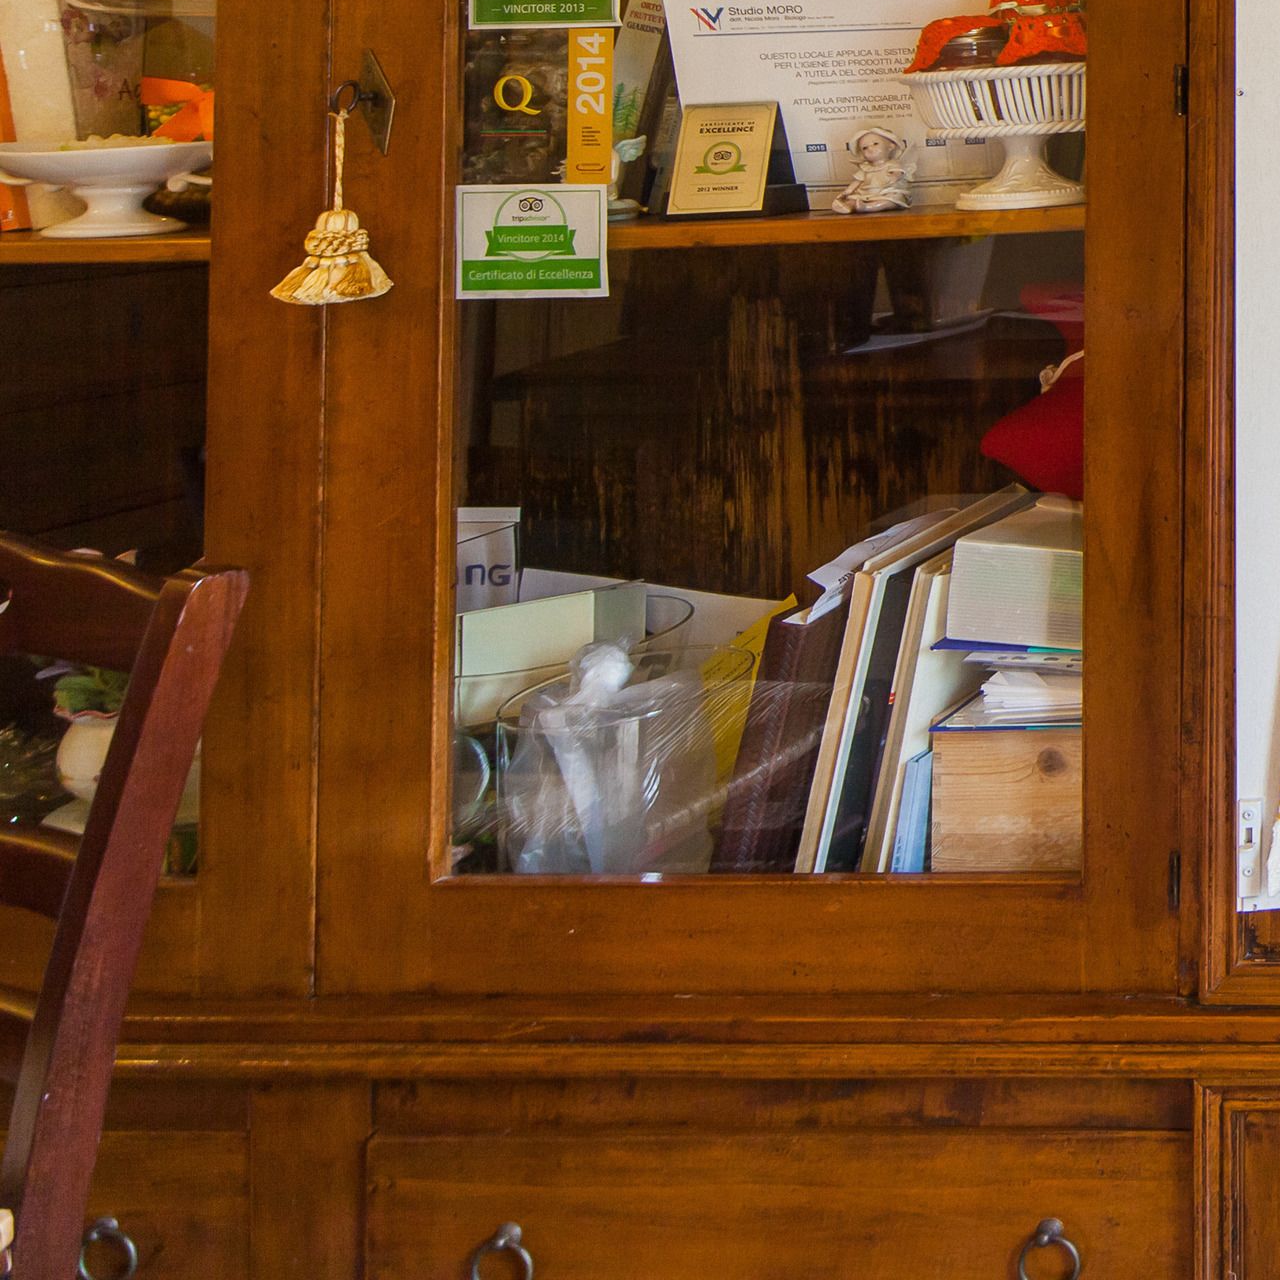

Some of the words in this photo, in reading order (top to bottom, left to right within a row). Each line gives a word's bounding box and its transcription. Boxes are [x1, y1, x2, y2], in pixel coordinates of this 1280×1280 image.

[503, 4, 556, 14] VINCITORE
[560, 3, 585, 13] 2013
[640, 1, 663, 12] ORTO
[728, 6, 764, 16] Studio
[766, 5, 803, 15] MORO
[759, 52, 797, 61] QUESTO
[799, 50, 834, 59] LOCALE
[836, 49, 873, 59] APPLICA
[874, 48, 883, 57] IL
[884, 47, 916, 57] SISTEM
[774, 61, 793, 70] PER
[795, 60, 830, 69] L'IGIENE
[831, 58, 847, 67] DEI
[848, 57, 892, 67] PRODOTTI
[575, 33, 606, 115] 2014
[804, 69, 838, 78] TUTELA
[839, 68, 857, 77] DEL
[493, 75, 542, 115] Q
[792, 97, 823, 107] ATTUA
[824, 96, 835, 105] LA
[814, 105, 859, 114] PRODOTTI
[860, 103, 912, 113] ALIMENTARI
[699, 126, 755, 134] EXCELLENCE
[497, 234, 541, 243] Vincitore
[542, 234, 565, 243] 2014
[468, 271, 524, 281] Certificato
[526, 270, 536, 280] di
[538, 270, 594, 280] Eccellenza
